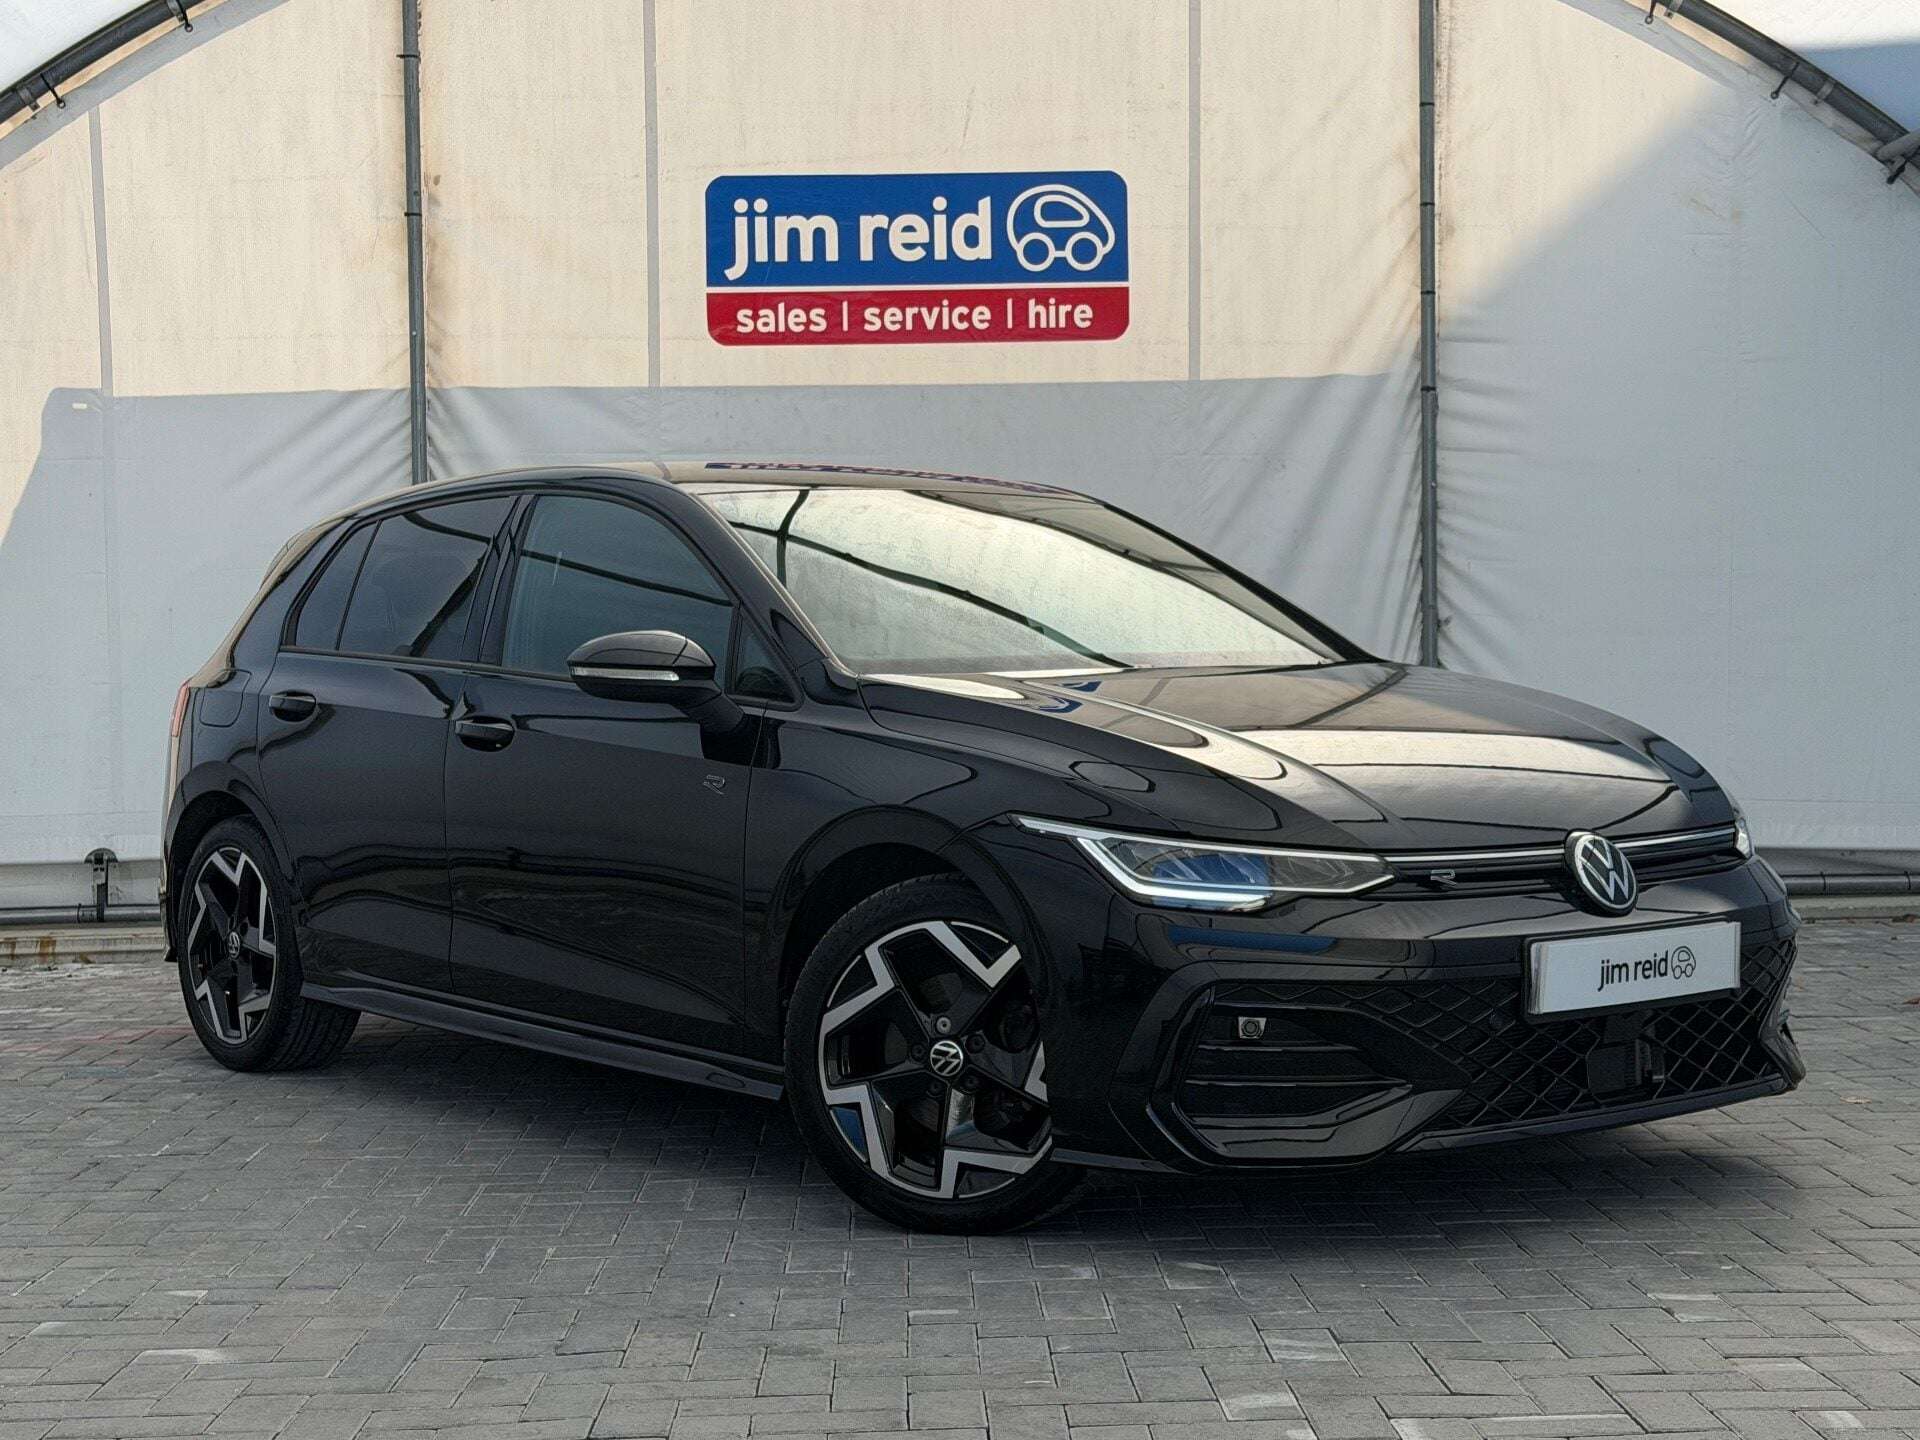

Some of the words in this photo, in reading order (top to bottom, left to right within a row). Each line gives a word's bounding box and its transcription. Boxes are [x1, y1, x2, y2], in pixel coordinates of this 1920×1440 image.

[724, 198, 838, 281] jim
[859, 196, 992, 262] reid
[736, 302, 827, 333] sales
[863, 299, 991, 331] service
[1028, 298, 1094, 329] hire
[1598, 960, 1629, 992] jim
[1633, 950, 1668, 982] reid
